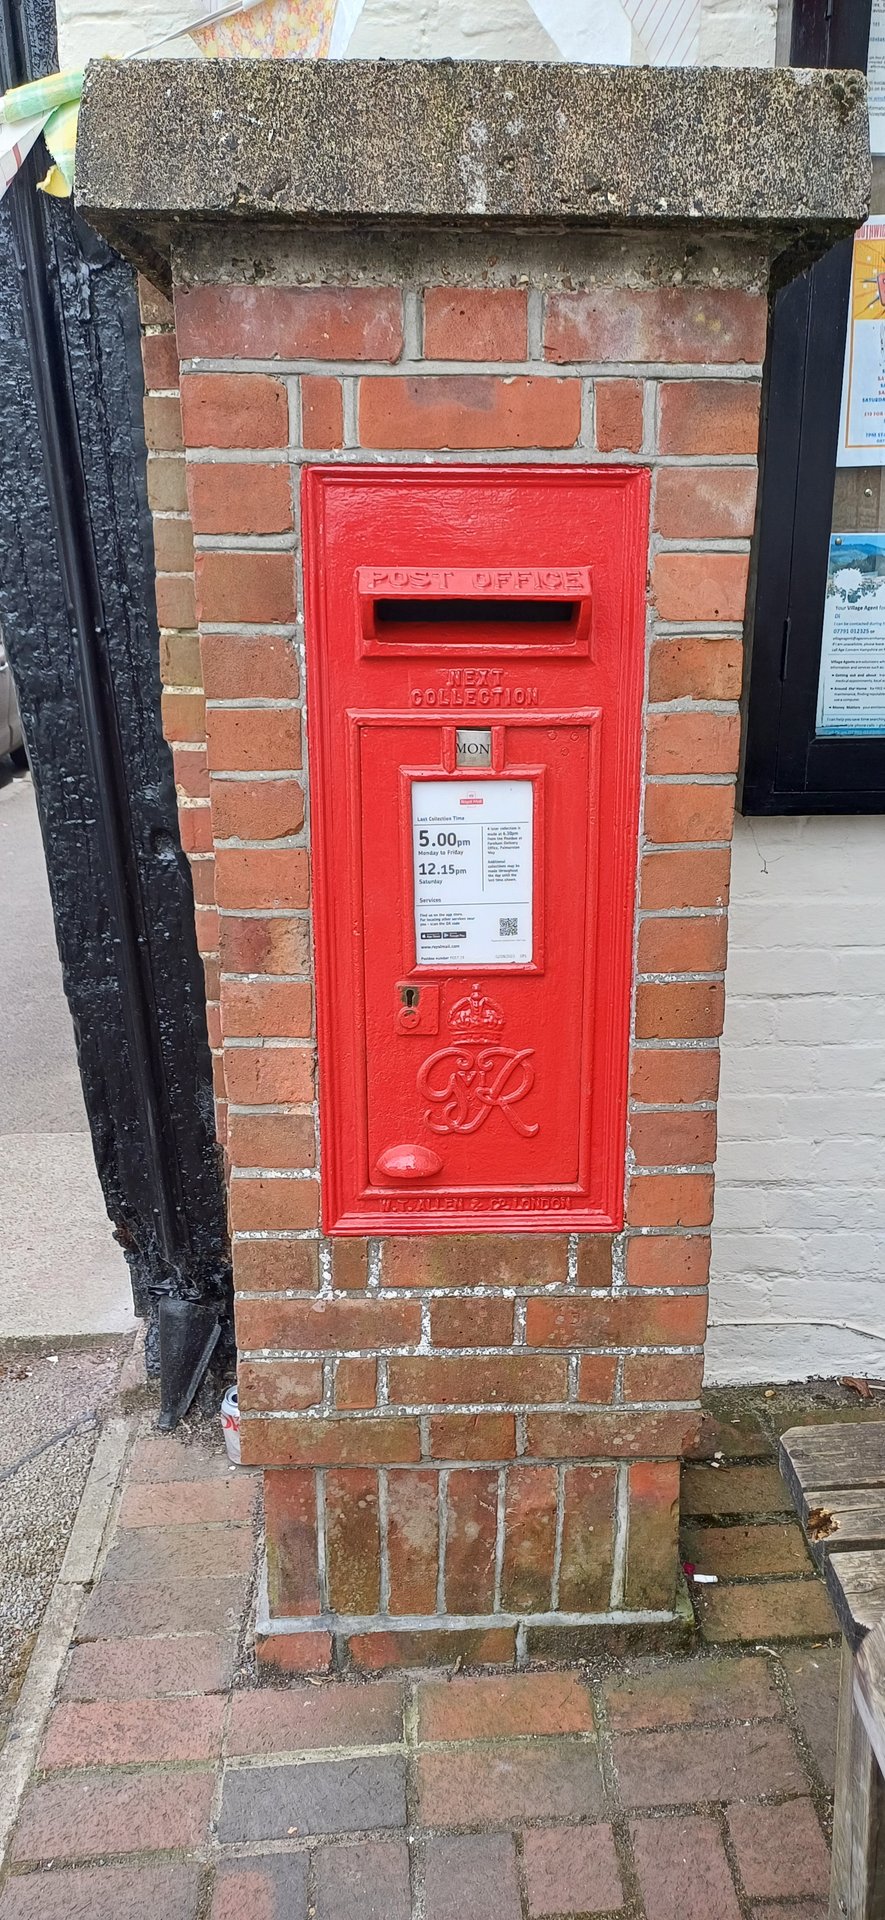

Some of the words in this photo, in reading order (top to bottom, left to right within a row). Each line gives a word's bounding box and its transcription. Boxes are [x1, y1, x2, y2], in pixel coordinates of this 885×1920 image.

[368, 572, 454, 589] POST
[473, 571, 583, 590] OFFICE
[447, 669, 504, 686] NEXT
[410, 688, 539, 706] COLLECTION
[456, 743, 490, 754] MON
[419, 830, 470, 847] 5.00pm
[419, 862, 467, 875] 12.15pm
[471, 1198, 483, 1211] &
[514, 1197, 571, 1211] LONDON
